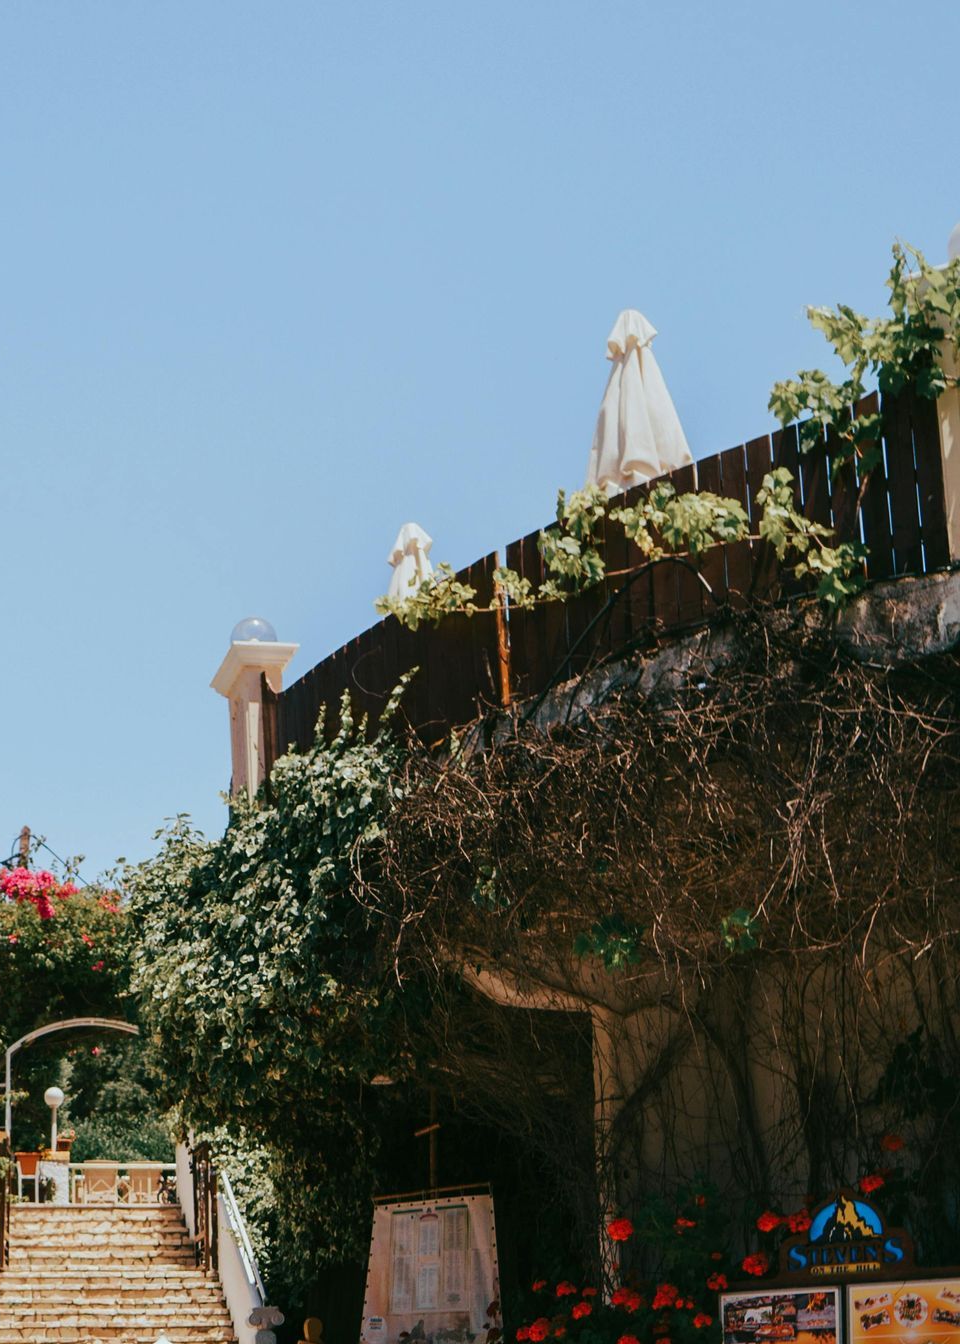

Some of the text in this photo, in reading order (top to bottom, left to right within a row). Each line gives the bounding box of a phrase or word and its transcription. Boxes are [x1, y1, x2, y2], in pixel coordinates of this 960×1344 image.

[810, 1261, 880, 1275] ON THE HILL
